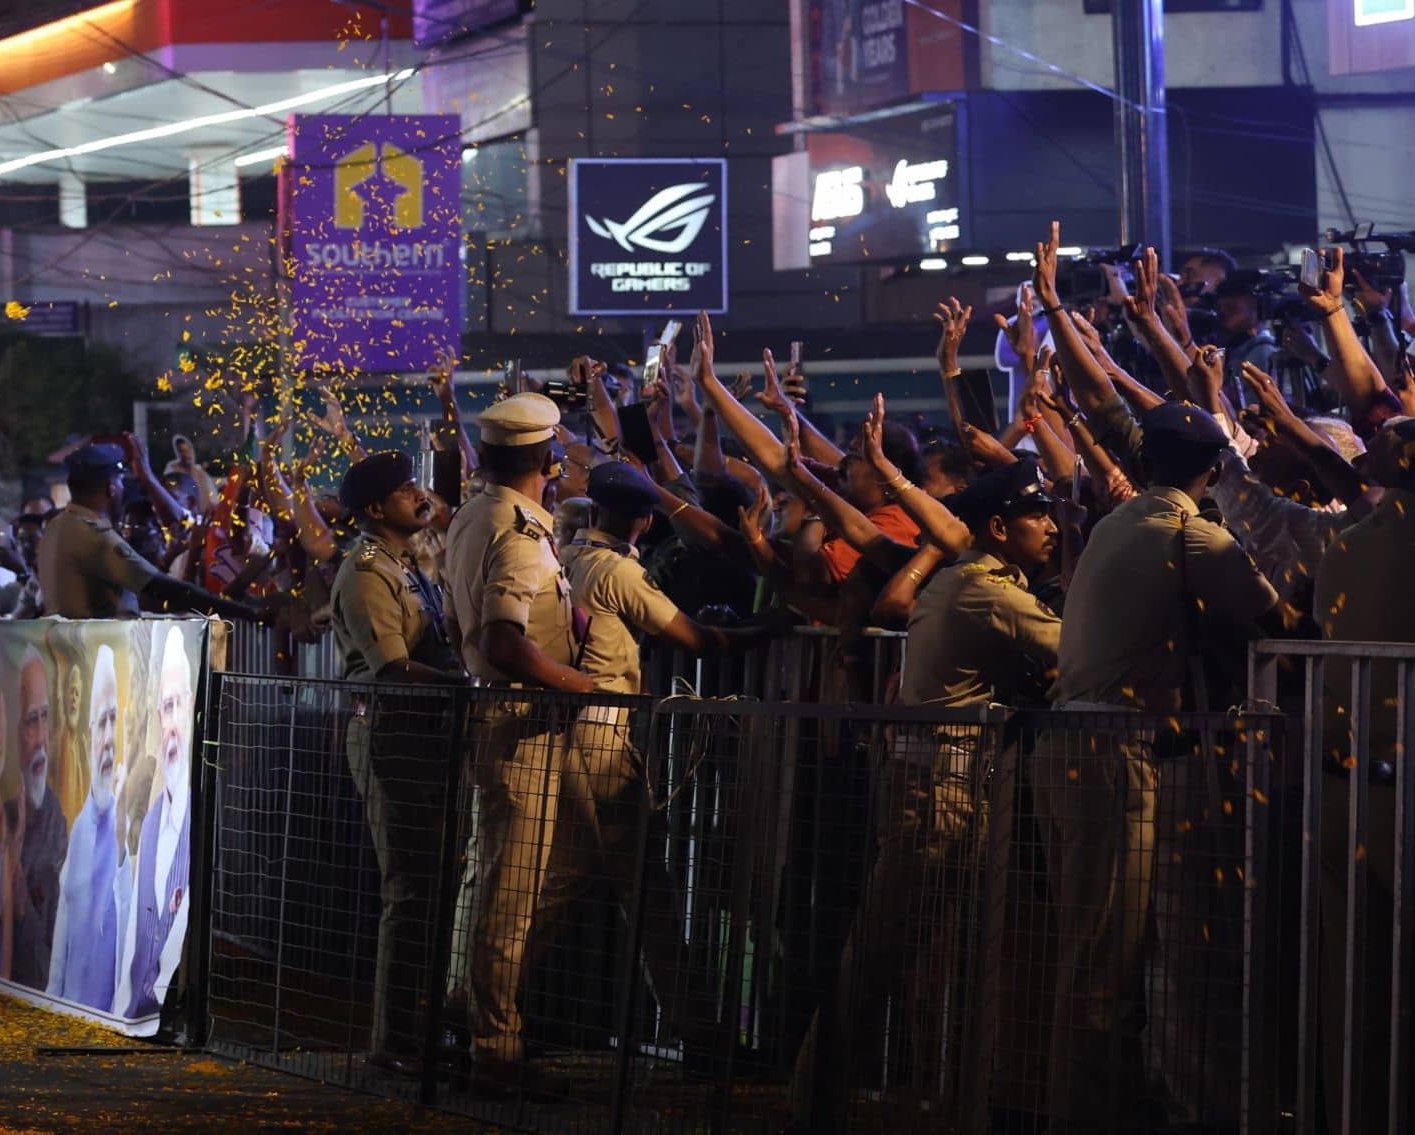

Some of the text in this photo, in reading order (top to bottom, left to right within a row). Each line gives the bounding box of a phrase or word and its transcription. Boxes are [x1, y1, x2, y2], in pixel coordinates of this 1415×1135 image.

[590, 262, 712, 279] REPUBLIC OF
[611, 277, 691, 292] GAMERS
